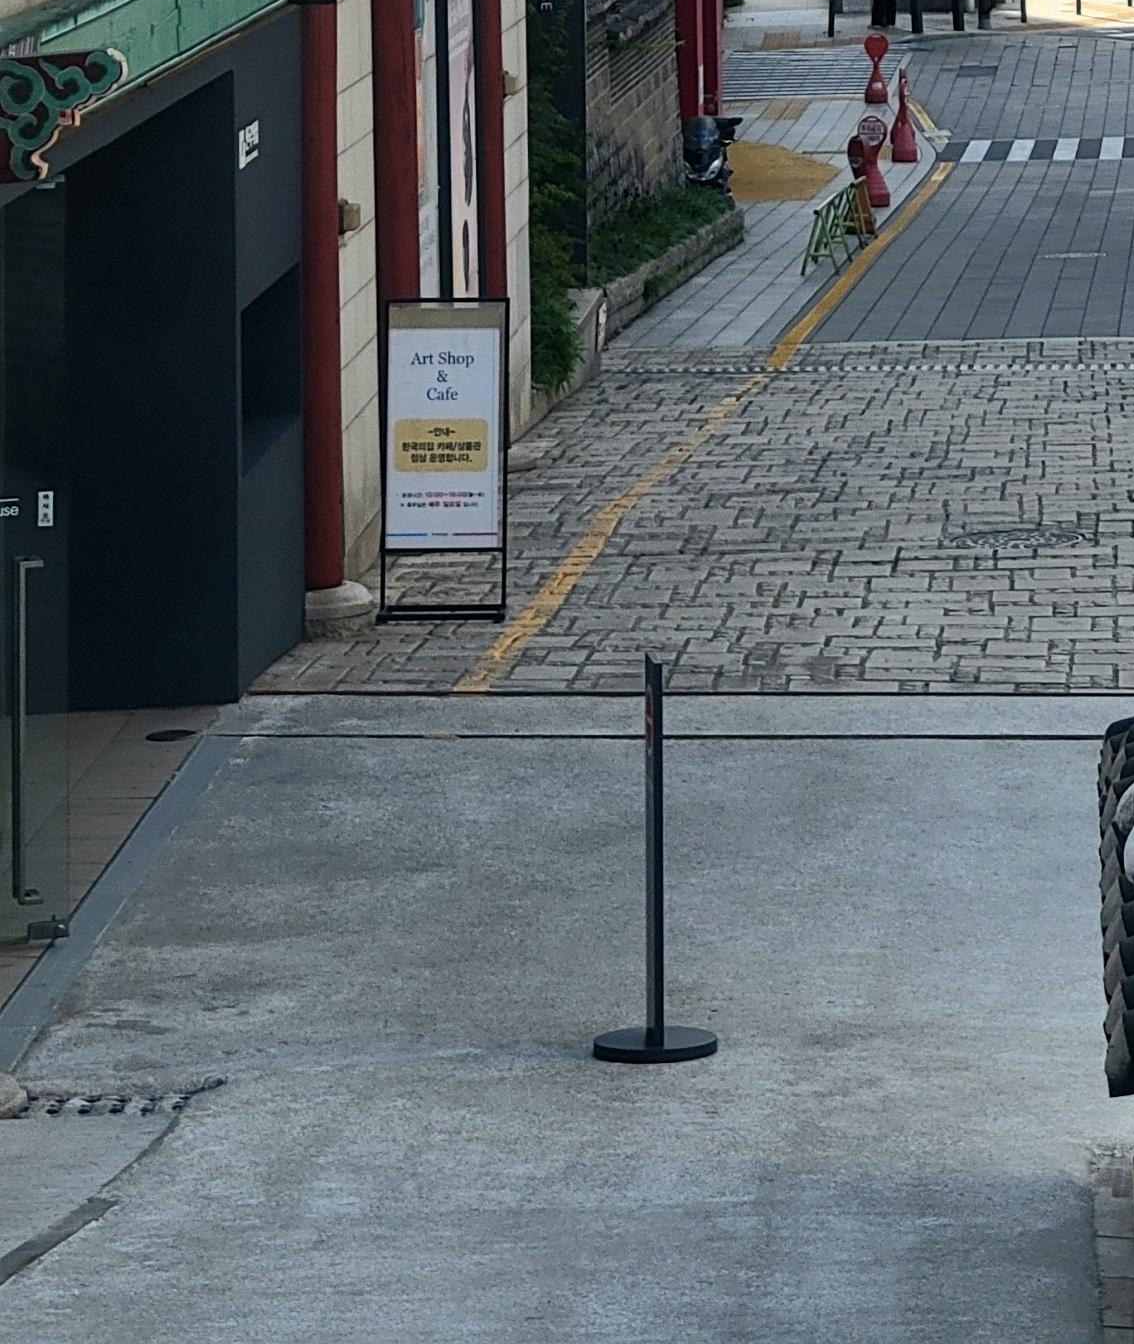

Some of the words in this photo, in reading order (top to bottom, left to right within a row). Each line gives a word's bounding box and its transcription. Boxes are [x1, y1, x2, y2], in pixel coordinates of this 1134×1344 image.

[410, 352, 434, 365] Art
[438, 351, 475, 368] Shop
[436, 369, 448, 383] &
[426, 387, 459, 400] Cafe
[402, 442, 434, 452] 한국의집
